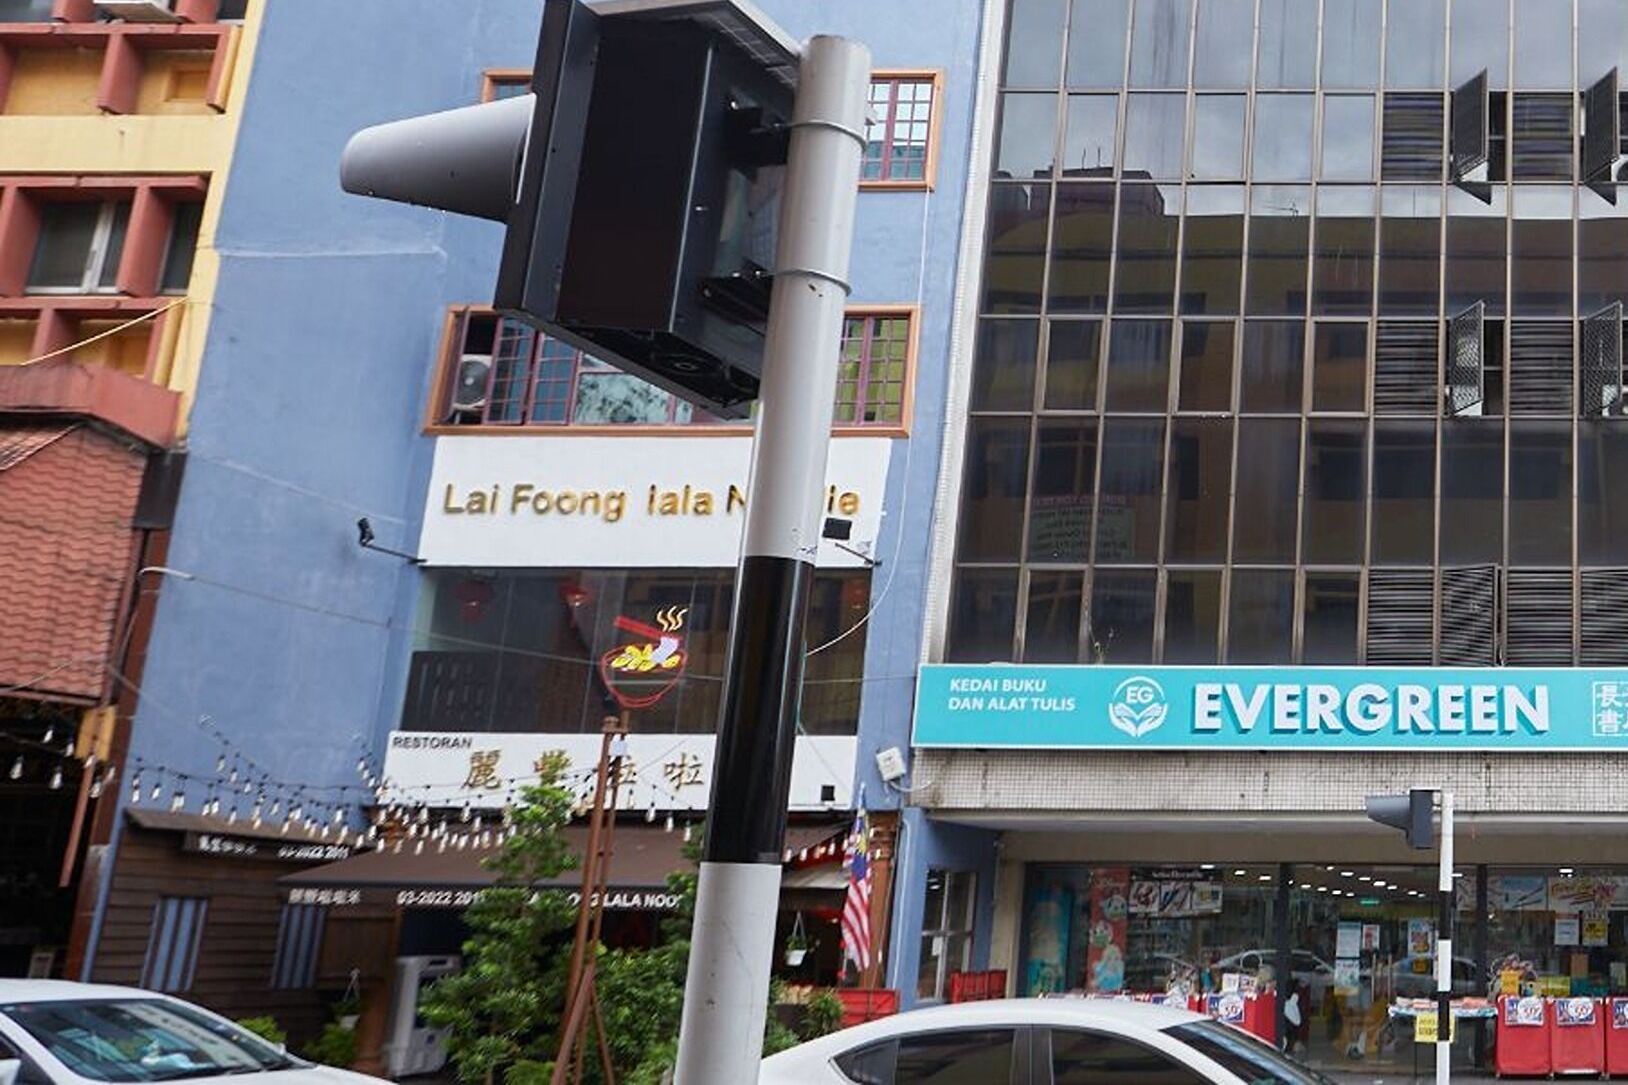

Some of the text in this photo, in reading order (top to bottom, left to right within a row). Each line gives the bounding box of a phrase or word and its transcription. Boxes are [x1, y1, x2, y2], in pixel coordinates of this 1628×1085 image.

[444, 484, 499, 515] Lai
[511, 484, 626, 522] Foong
[950, 678, 1047, 692] KEDAI BUKU
[1125, 685, 1154, 704] EG
[948, 697, 1076, 712] DAN ALAT TULIS
[1191, 682, 1551, 736] EVERGREEN
[392, 737, 473, 750] RESTORAN
[602, 892, 641, 907] LALA
